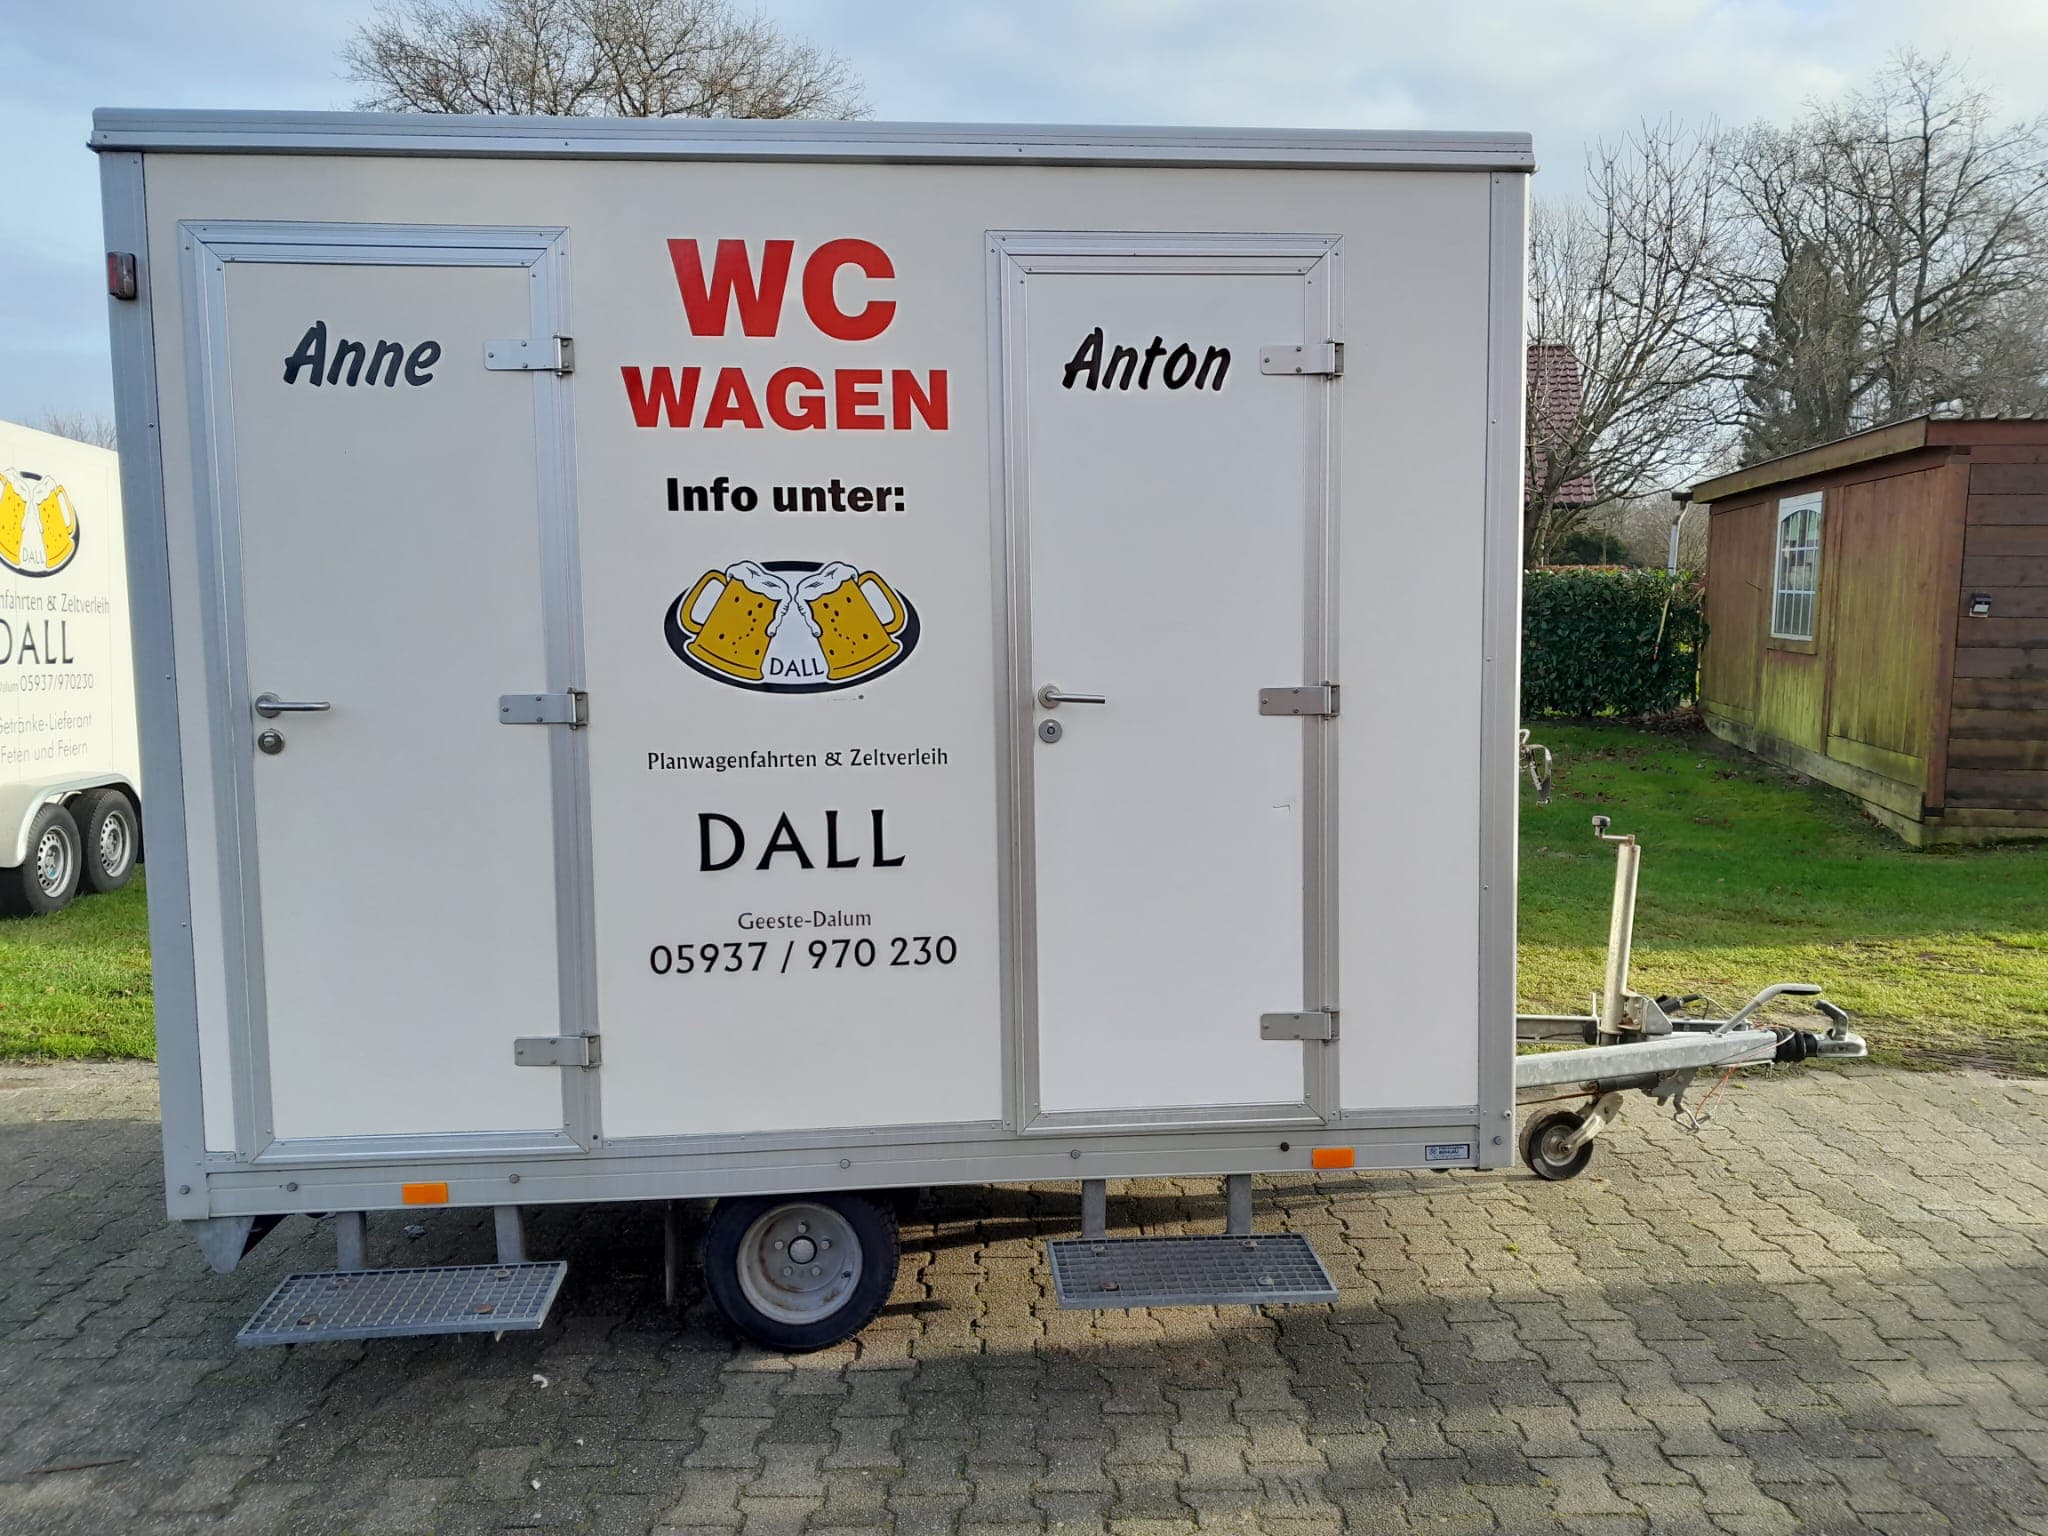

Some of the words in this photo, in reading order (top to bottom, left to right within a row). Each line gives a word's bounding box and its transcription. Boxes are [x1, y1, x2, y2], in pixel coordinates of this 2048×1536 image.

[668, 238, 897, 342] WC
[283, 320, 442, 388] Anne
[1062, 326, 1232, 392] Anton
[621, 366, 949, 432] WAGEN
[667, 477, 758, 512] Info
[773, 479, 905, 512] unter:
[22, 547, 45, 564] DALL
[47, 595, 57, 611] &
[61, 593, 110, 615] Zeltverleih
[769, 657, 825, 677] DALL
[34, 740, 54, 761] und
[648, 750, 817, 772] Planwagenfahrten
[825, 751, 843, 767] &
[850, 748, 949, 767] Zeltverleih
[698, 809, 906, 872] DALL
[738, 910, 872, 930] Geeste-Dalum
[650, 940, 768, 975] 05937
[780, 940, 795, 974] /
[808, 938, 876, 970] 970
[890, 935, 958, 967] 230
